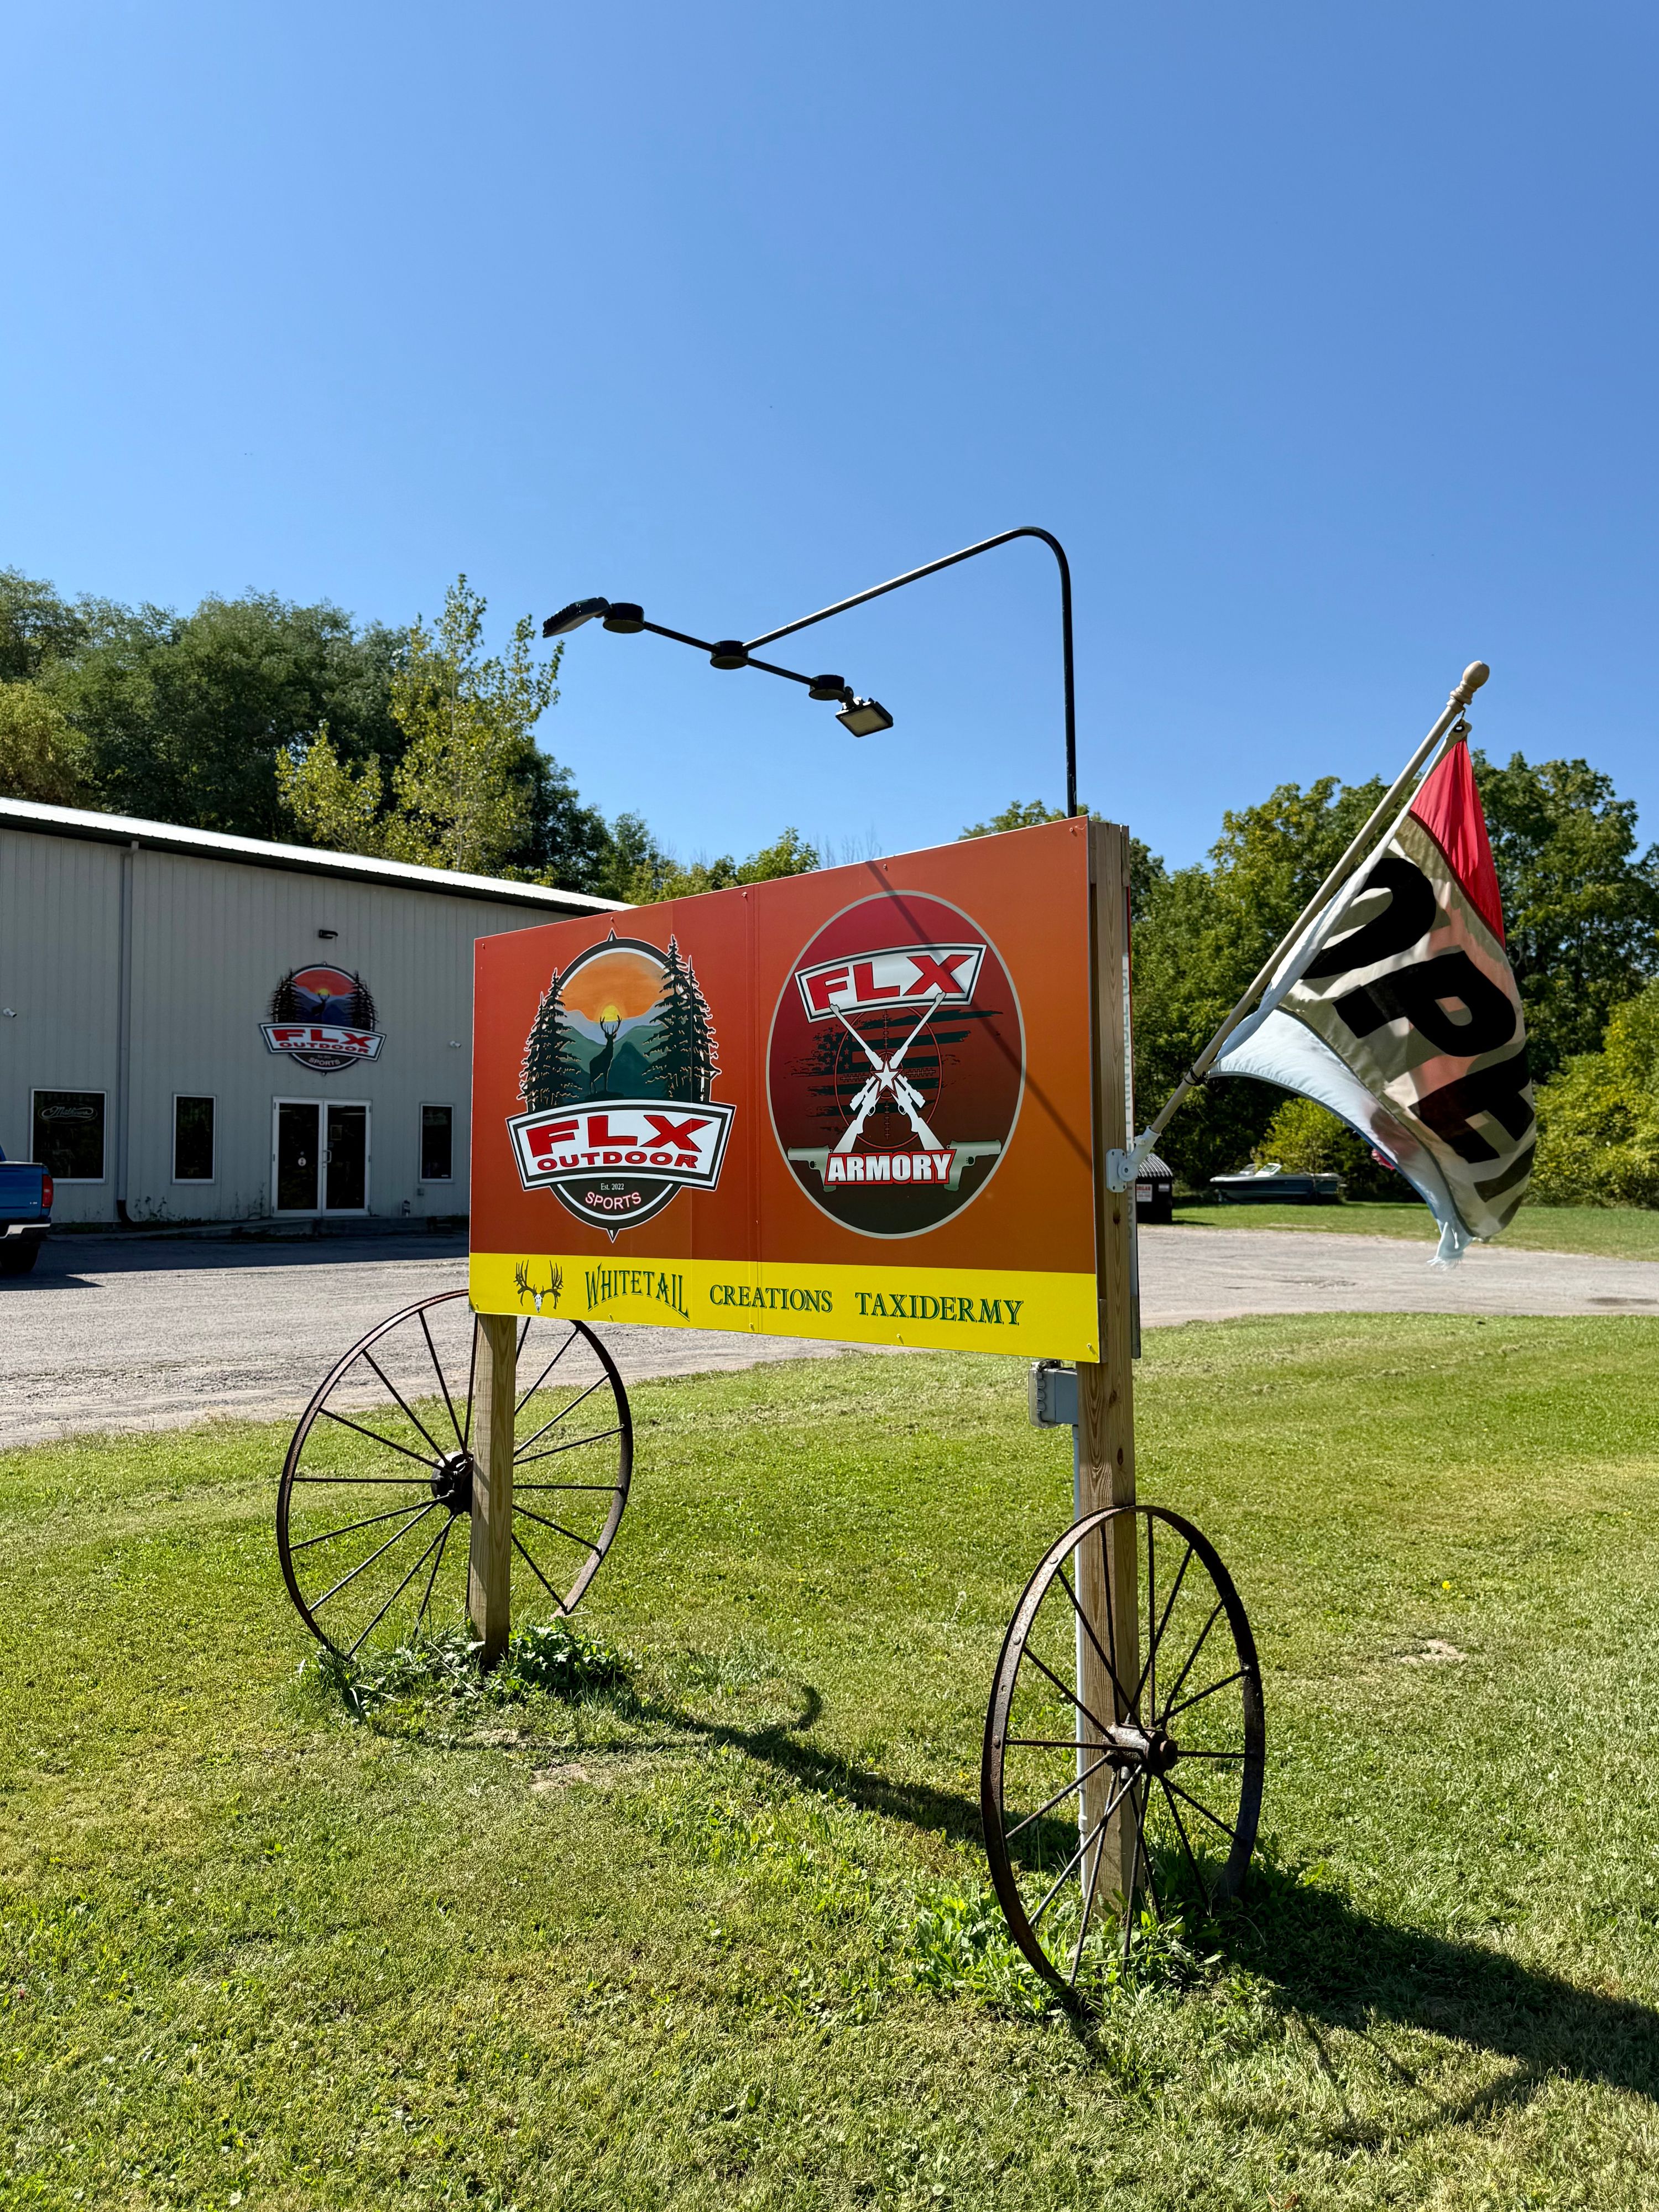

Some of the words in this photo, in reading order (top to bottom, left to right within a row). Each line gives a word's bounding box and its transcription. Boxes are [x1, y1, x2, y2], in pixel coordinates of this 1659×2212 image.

[806, 954, 974, 1011] FLX
[272, 1029, 376, 1049] FLX
[279, 1042, 369, 1054] OUTDOOR
[309, 1057, 341, 1067] SPORTS
[526, 1114, 714, 1158] FLX
[537, 1151, 698, 1171] OUTDOOR
[827, 1153, 952, 1182] ARMORY
[600, 1182, 609, 1191] Est.
[611, 1182, 624, 1191] 2022
[585, 1191, 642, 1211] SPORTS
[585, 1261, 690, 1322] WHITETAIL
[709, 1284, 833, 1313] CREATIONS
[854, 1292, 1024, 1326] TAXIDERMY
